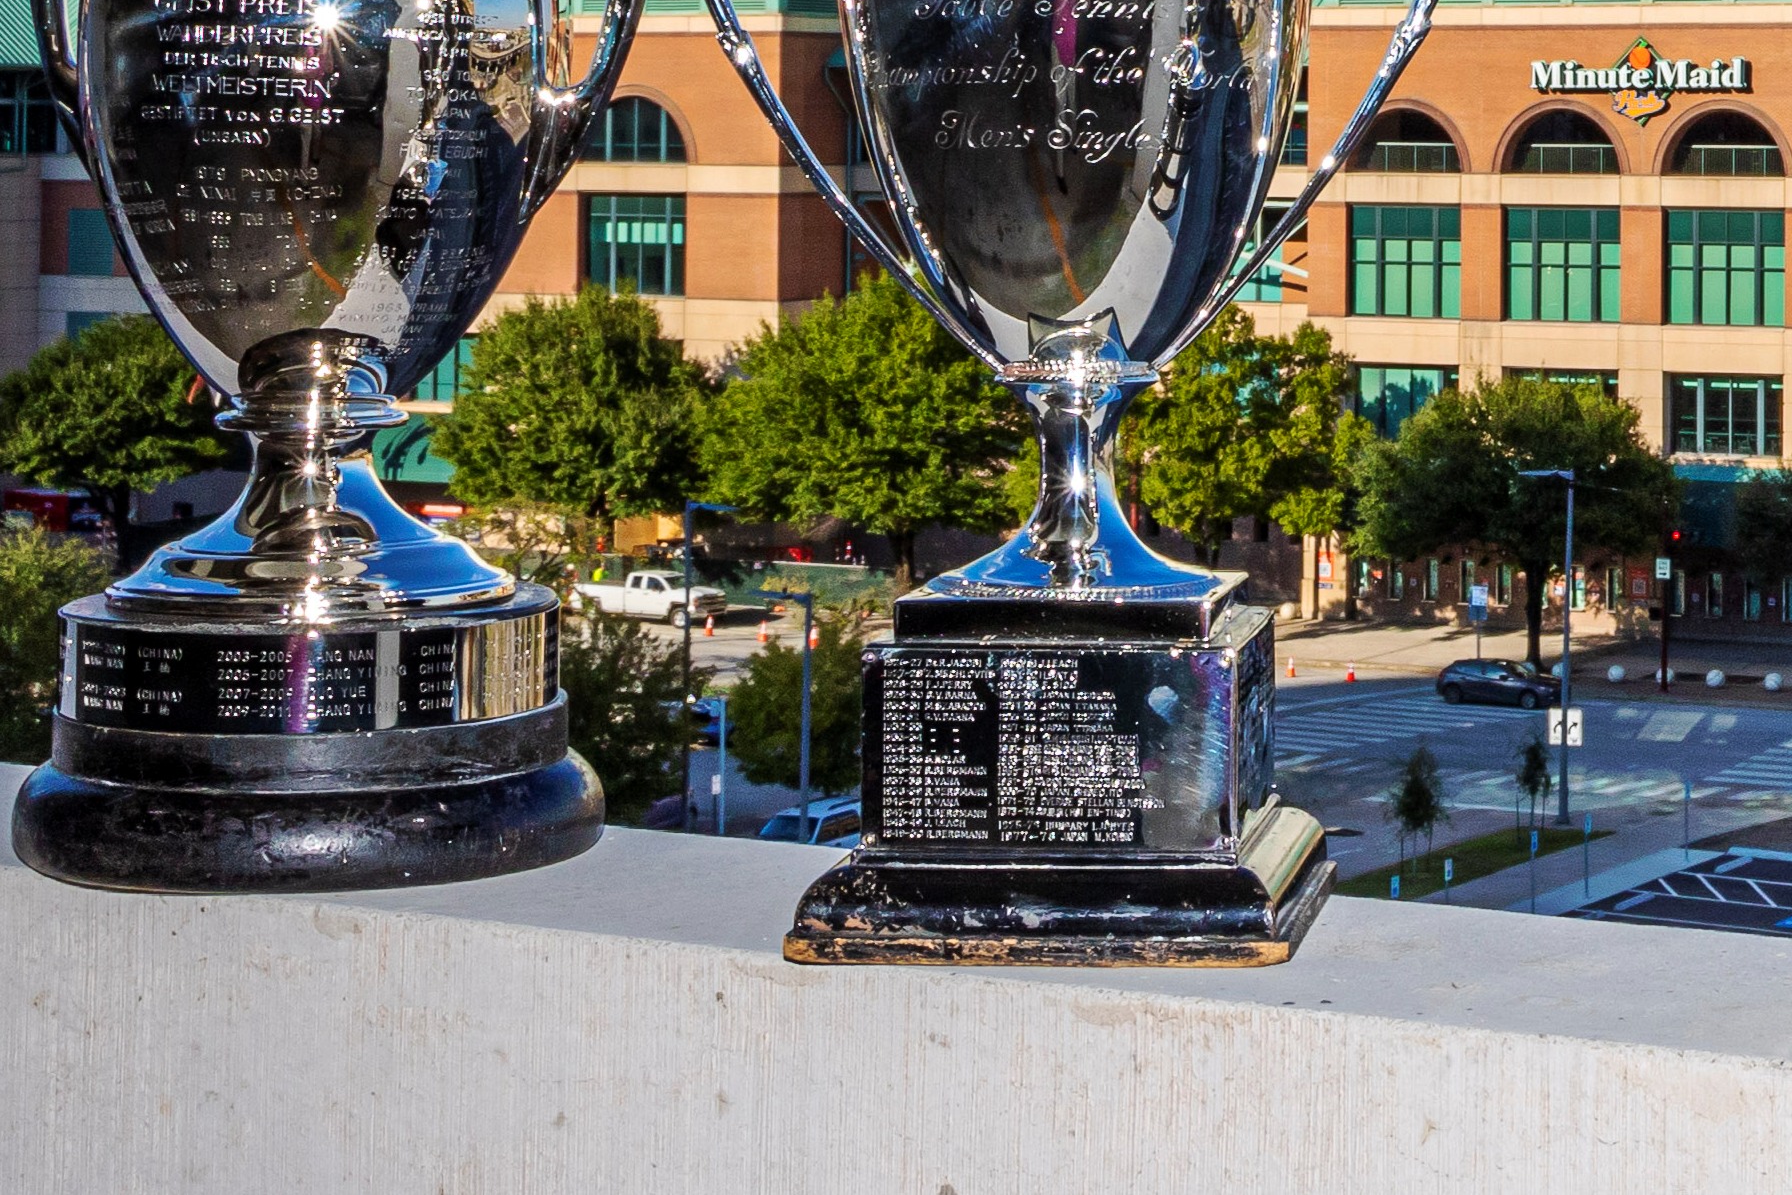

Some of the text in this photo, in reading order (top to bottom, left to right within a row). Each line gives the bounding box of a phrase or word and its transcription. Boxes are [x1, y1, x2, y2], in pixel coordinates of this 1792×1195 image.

[1051, 47, 1102, 98] of
[1092, 45, 1145, 86] the
[1530, 57, 1748, 89] Minute Maid
[152, 73, 332, 99] WELTMEISTERIN
[307, 649, 343, 663] ANG
[349, 649, 375, 661] NAN
[419, 661, 456, 675] CHINA
[341, 685, 367, 698] YUE
[419, 679, 456, 693] CHINA
[418, 697, 456, 711] CHINA
